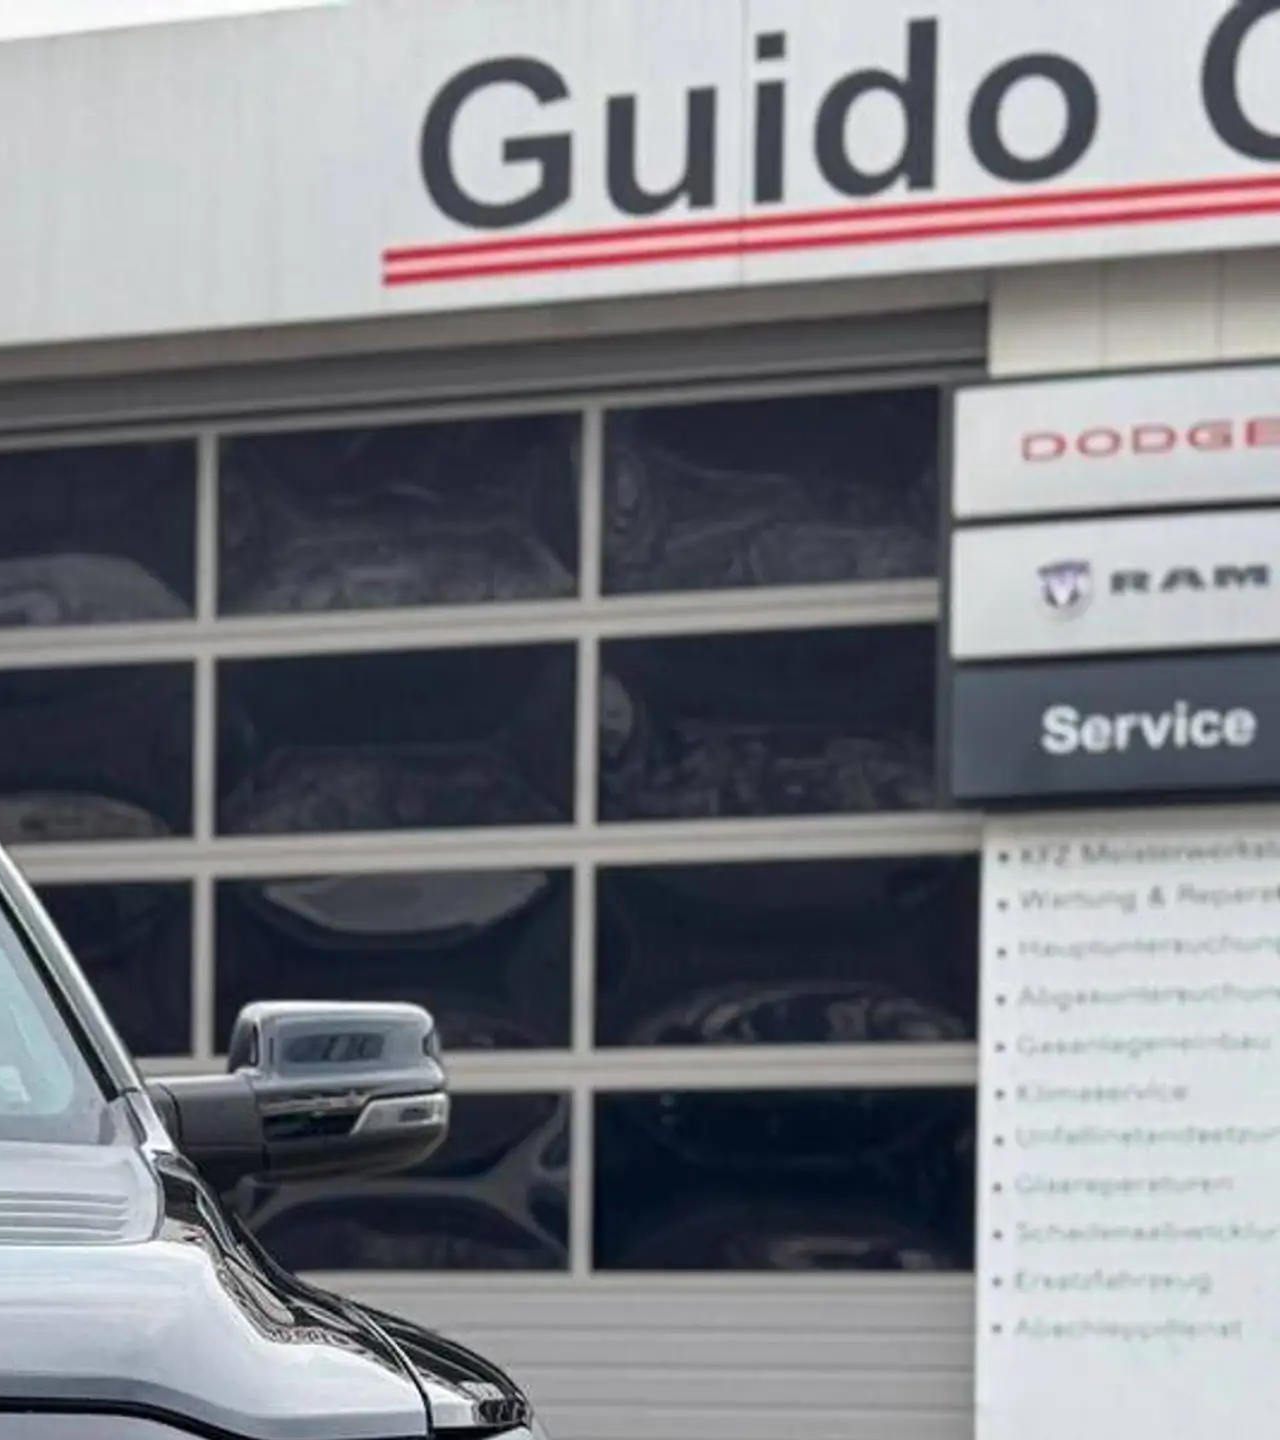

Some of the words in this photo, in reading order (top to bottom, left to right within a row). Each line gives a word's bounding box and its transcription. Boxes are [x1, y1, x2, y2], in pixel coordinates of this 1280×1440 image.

[419, 17, 1099, 230] Guido
[1020, 418, 1280, 462] DODGE
[1109, 564, 1270, 595] RAM
[1041, 700, 1257, 755] Service
